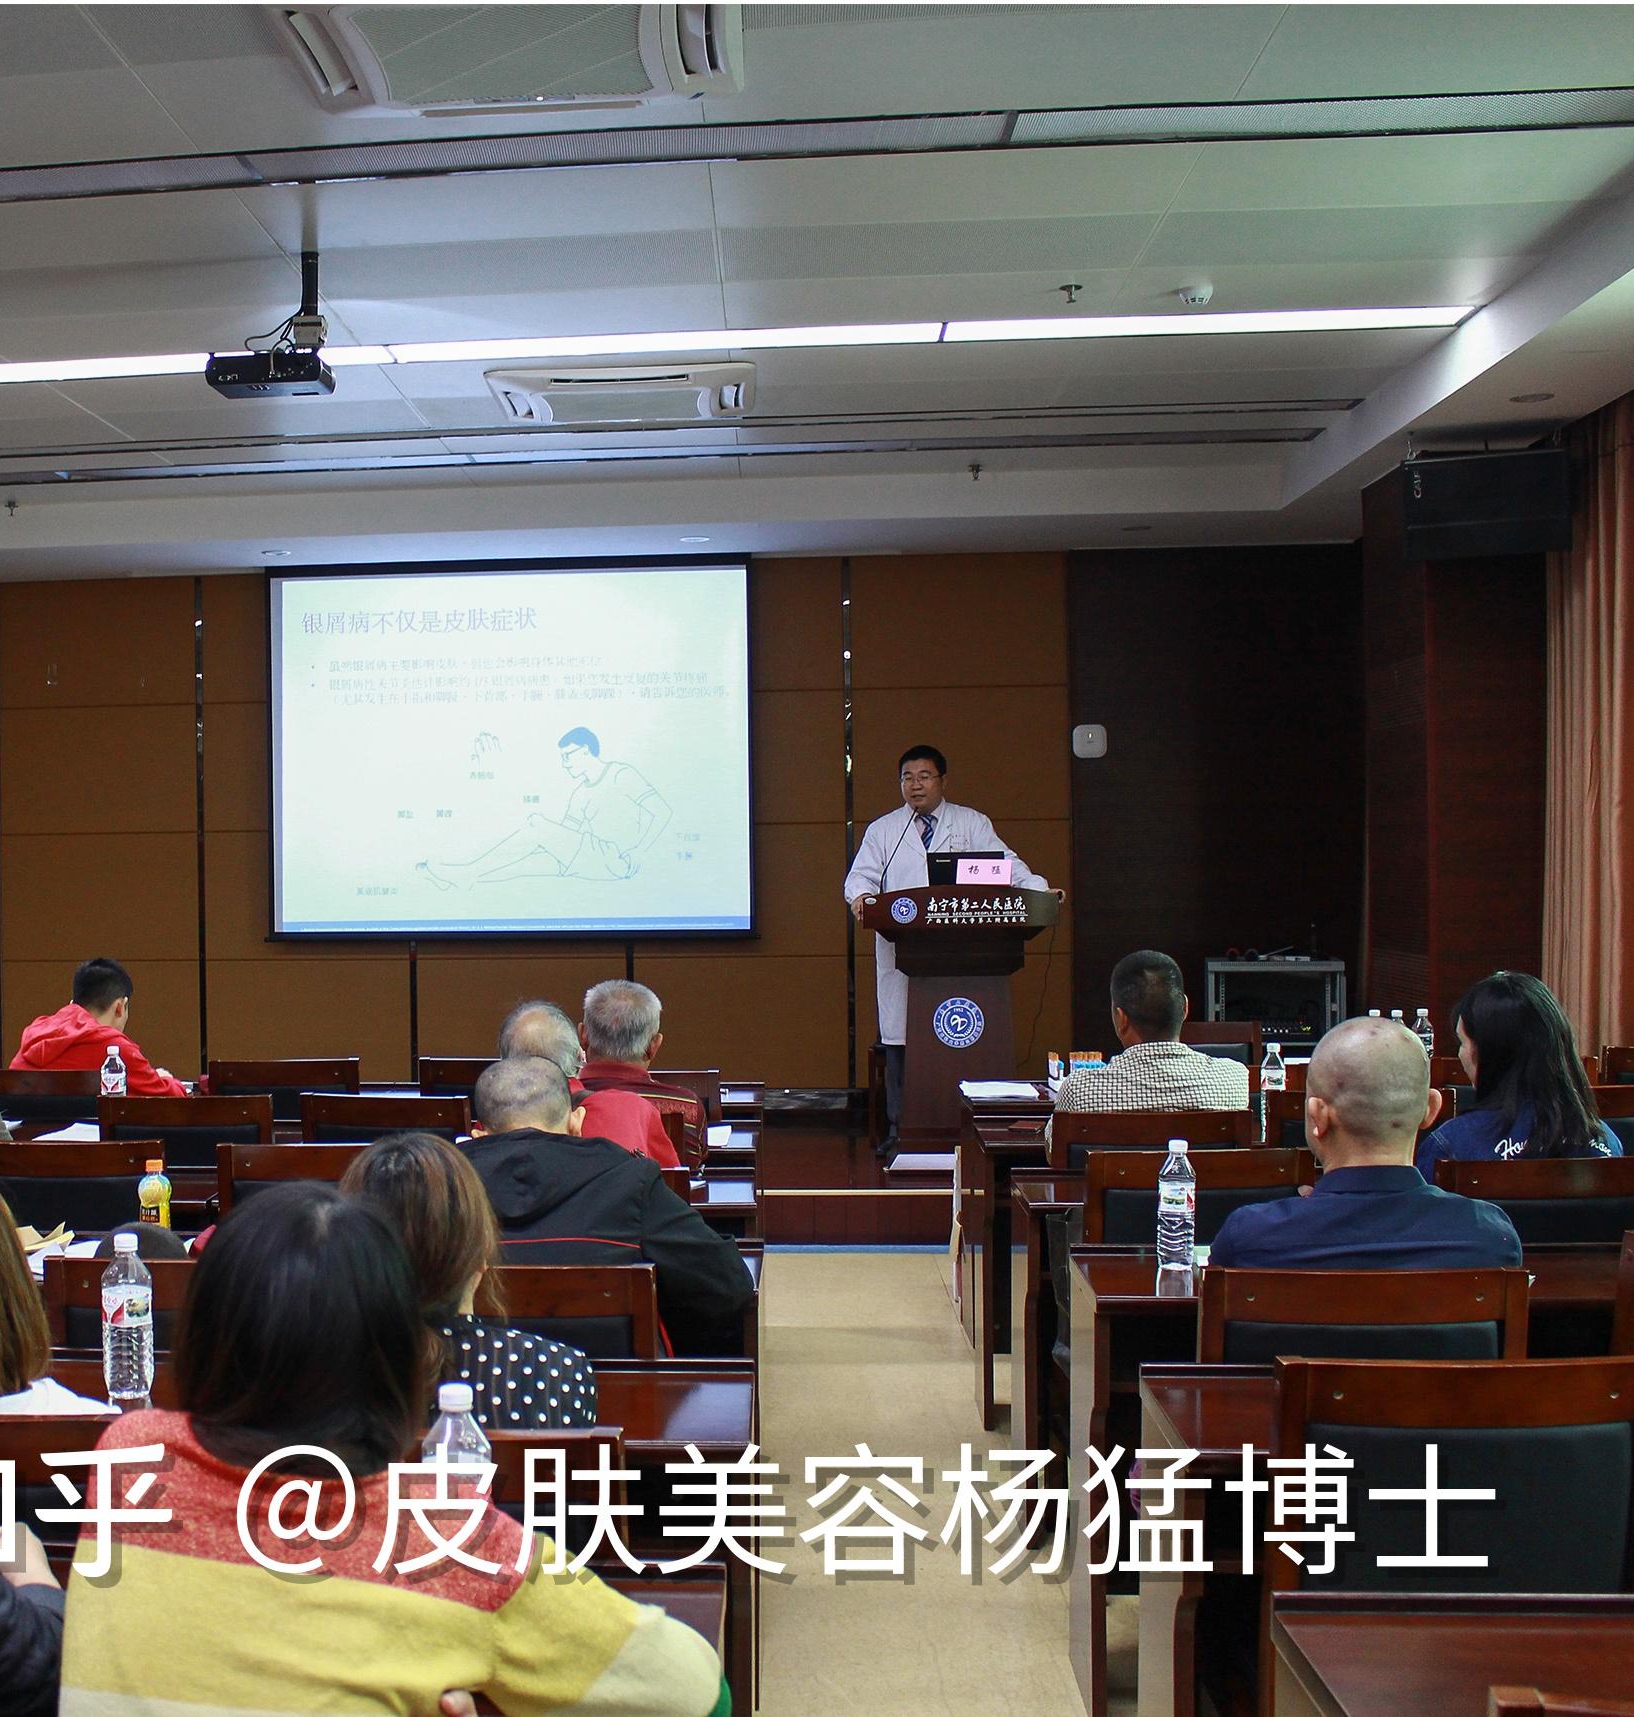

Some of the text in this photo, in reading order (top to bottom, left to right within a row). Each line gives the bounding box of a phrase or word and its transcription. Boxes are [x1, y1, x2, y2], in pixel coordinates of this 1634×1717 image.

[301, 607, 538, 635] 银屑病不仅是皮肤症状
[927, 896, 1026, 912] 南宁市第二人民医院
